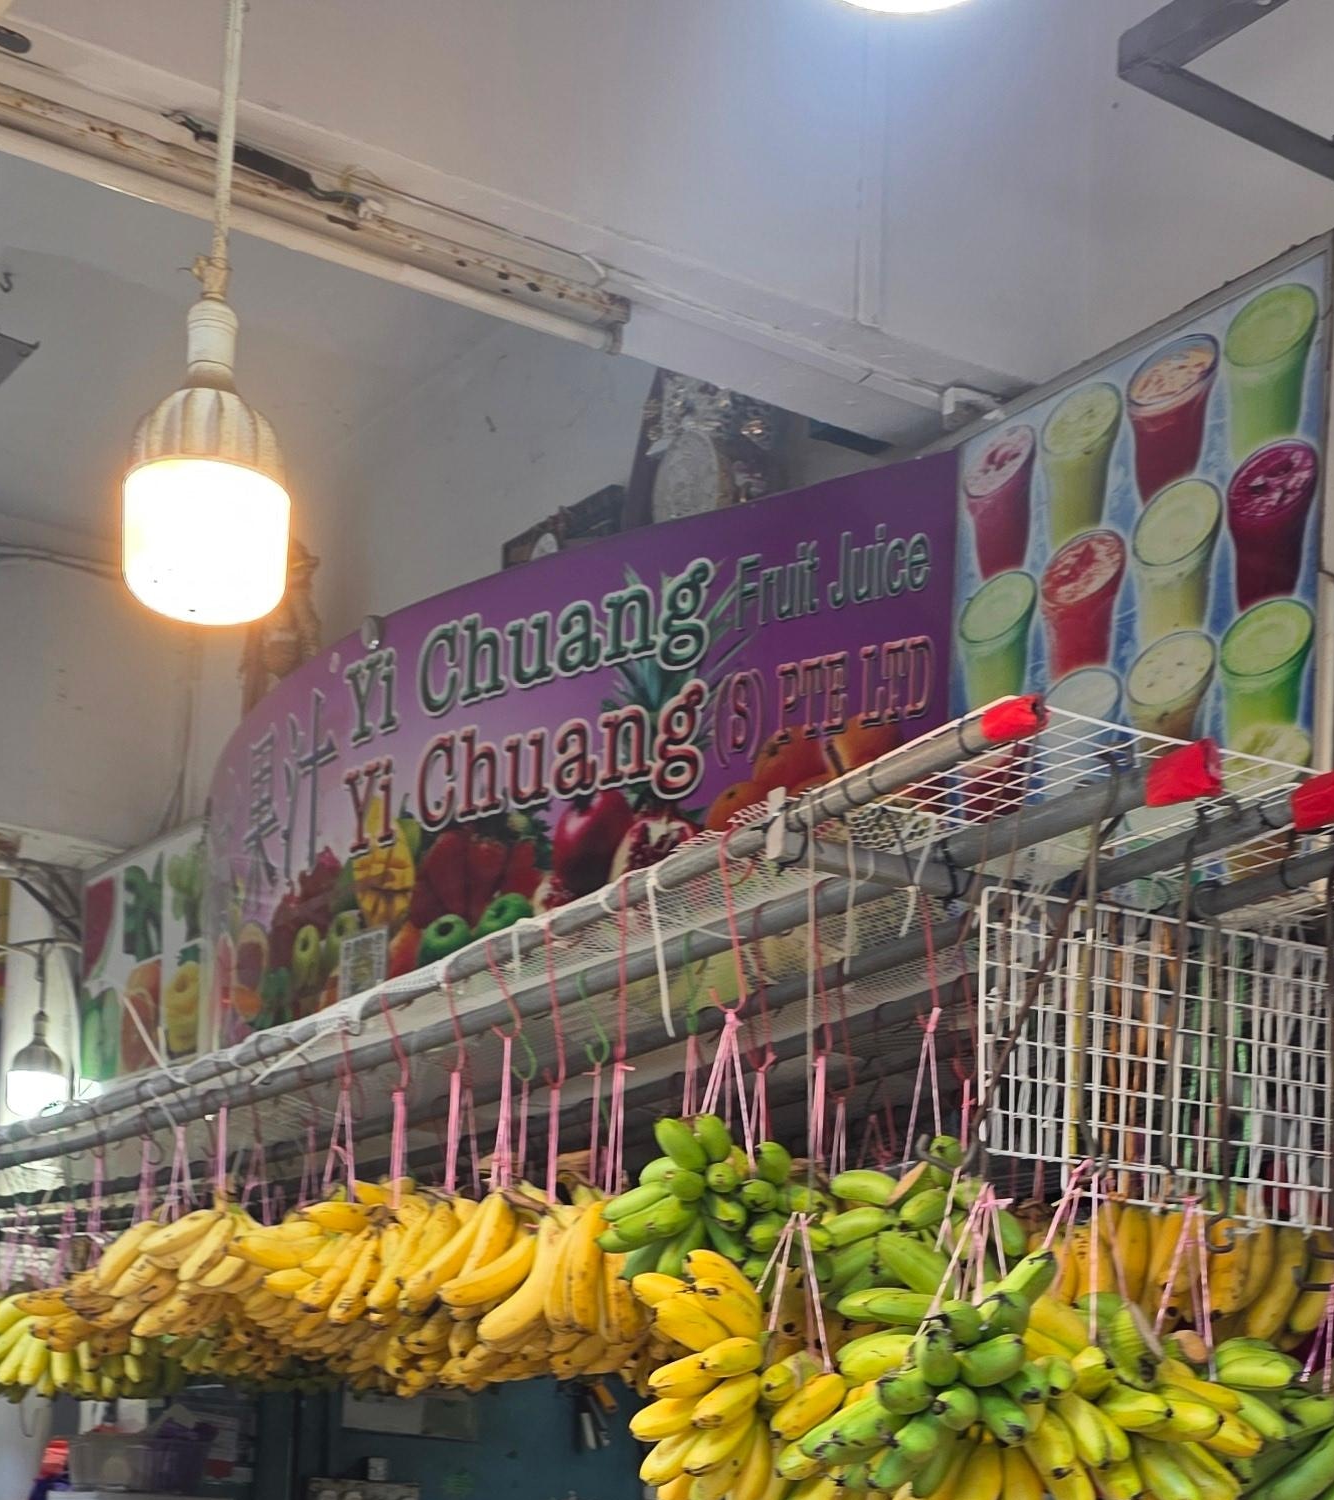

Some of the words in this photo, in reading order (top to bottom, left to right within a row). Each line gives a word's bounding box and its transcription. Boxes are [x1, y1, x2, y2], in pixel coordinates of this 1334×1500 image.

[344, 647, 398, 748] Yi
[418, 557, 716, 718] Chuang
[735, 540, 820, 632] Fruit
[828, 522, 932, 610] Juice
[343, 756, 396, 859] Yi
[417, 678, 710, 832] Chuang
[713, 667, 763, 769] (S)
[774, 650, 849, 745] PTE
[858, 635, 936, 729] LTD
